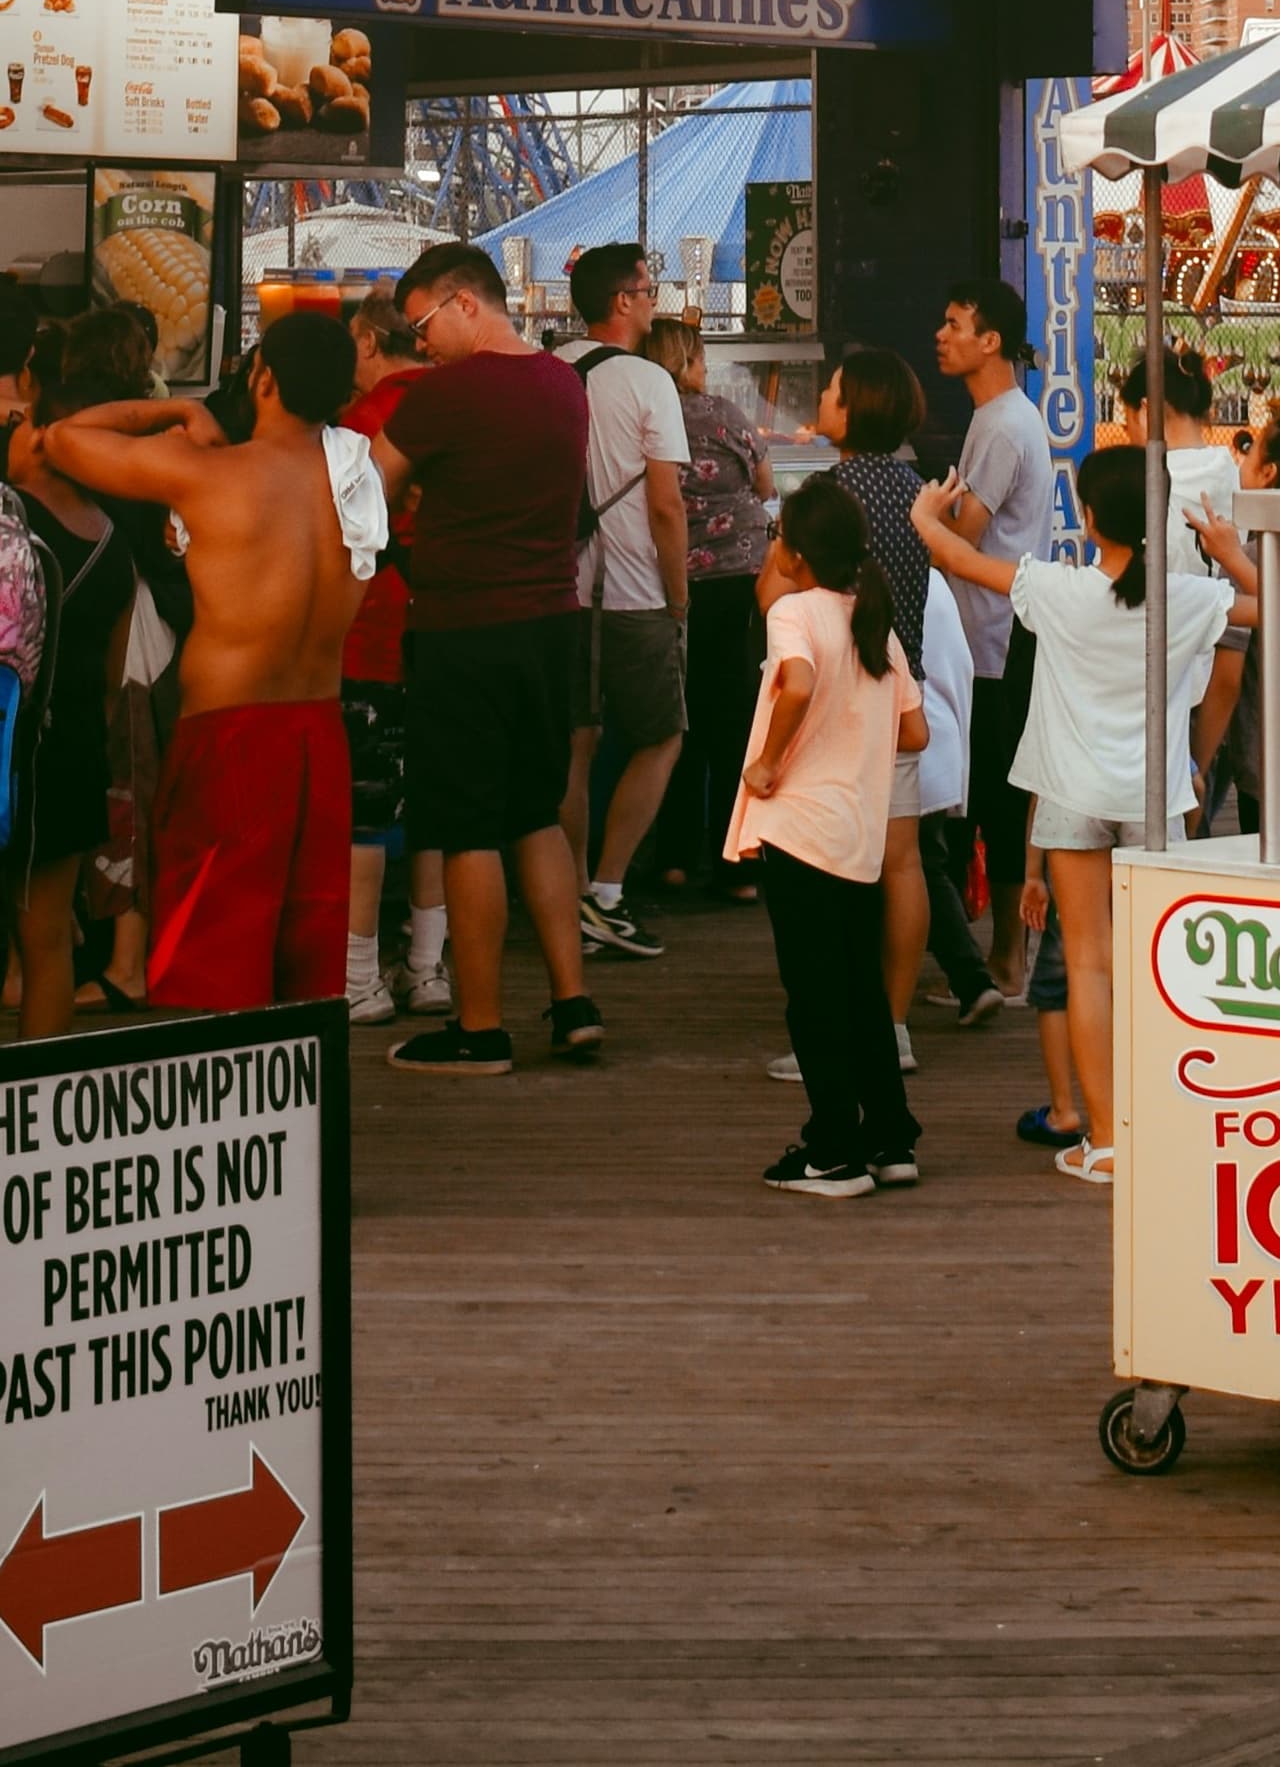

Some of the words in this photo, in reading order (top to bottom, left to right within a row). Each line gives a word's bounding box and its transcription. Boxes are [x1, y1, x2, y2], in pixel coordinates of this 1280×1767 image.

[61, 54, 75, 68] Dog
[142, 96, 165, 109] Drinks
[119, 181, 155, 190] Natural
[156, 181, 189, 192] Length
[121, 195, 182, 216] Corn
[117, 217, 134, 226] on
[136, 216, 158, 227] the
[160, 216, 185, 228] cob
[53, 1041, 318, 1147] CONSUMPTION
[3, 1170, 52, 1245] OF
[66, 1154, 161, 1234] BEER
[173, 1145, 205, 1215] IS
[217, 1131, 287, 1207] NOT
[44, 1224, 252, 1327] PERMITTED
[88, 1324, 172, 1405] THIS
[184, 1296, 306, 1386] POINT!
[205, 1386, 270, 1433] THANK
[276, 1374, 321, 1416] YOU!
[193, 1619, 320, 1680] Nathan's
